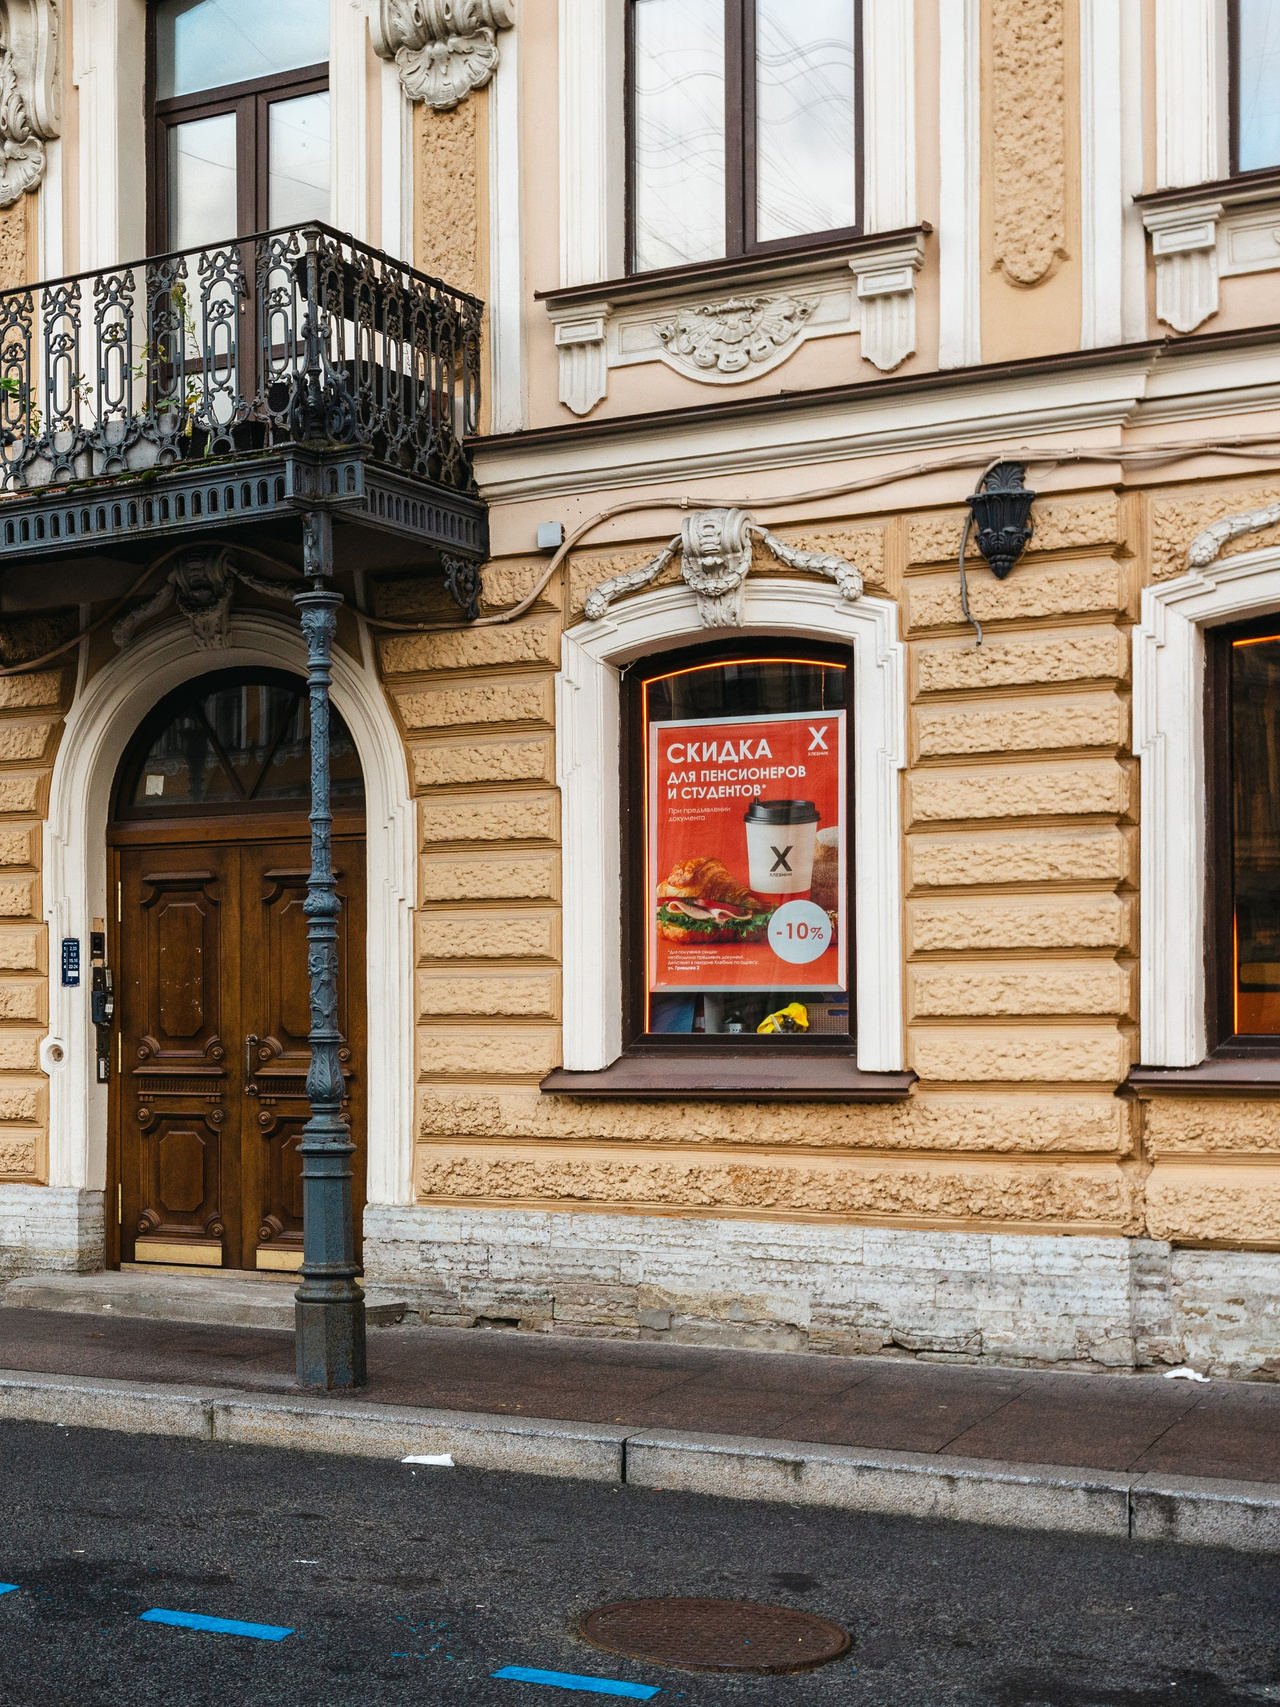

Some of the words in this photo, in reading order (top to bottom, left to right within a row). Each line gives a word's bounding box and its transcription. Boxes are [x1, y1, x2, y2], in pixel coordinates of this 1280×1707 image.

[666, 738, 772, 763] СКИДКА
[667, 771, 696, 785] ДЛЯ
[700, 765, 806, 782] ПЕНСИОНЕРОВ
[667, 788, 677, 799] И
[668, 807, 682, 815] При
[683, 806, 731, 814] предъявлении
[776, 922, 824, 940] -10%
